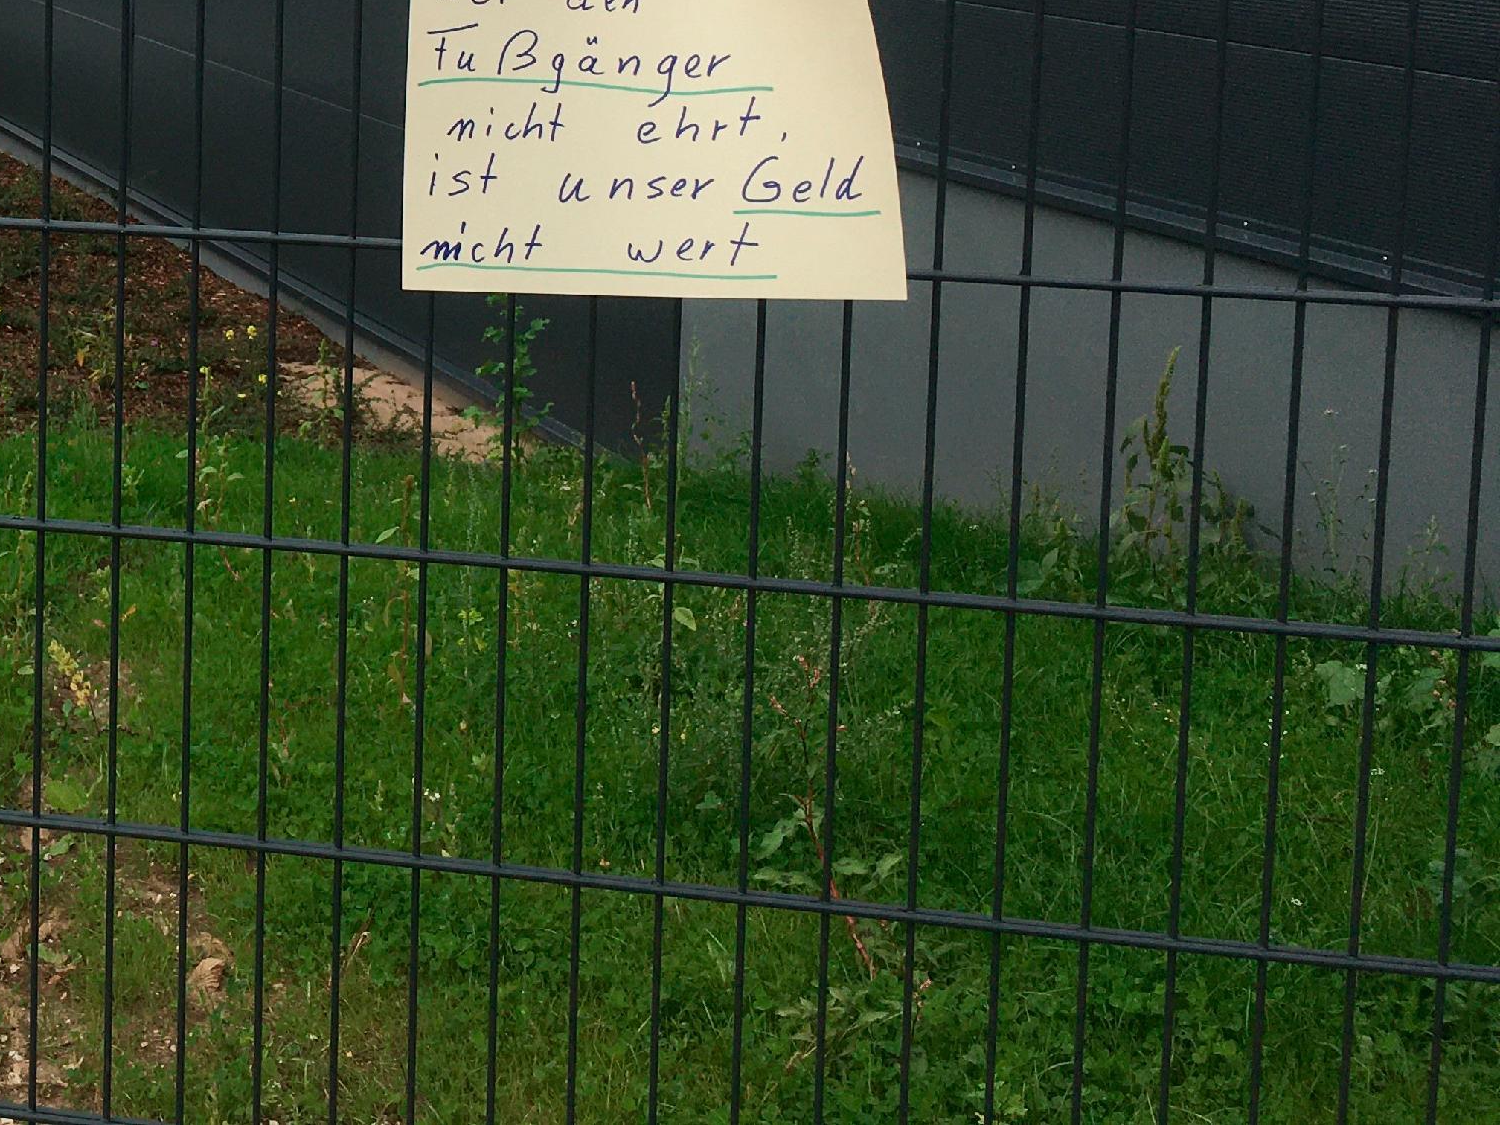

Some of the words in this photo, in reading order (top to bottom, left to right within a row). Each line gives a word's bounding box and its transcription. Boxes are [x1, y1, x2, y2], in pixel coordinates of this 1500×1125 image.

[427, 23, 732, 108] Fußgänger
[447, 102, 565, 142] nicht
[429, 152, 498, 196] ist
[558, 175, 715, 203] unser
[741, 155, 864, 203] Geld
[420, 221, 543, 264] nicht
[627, 221, 759, 266] wert
